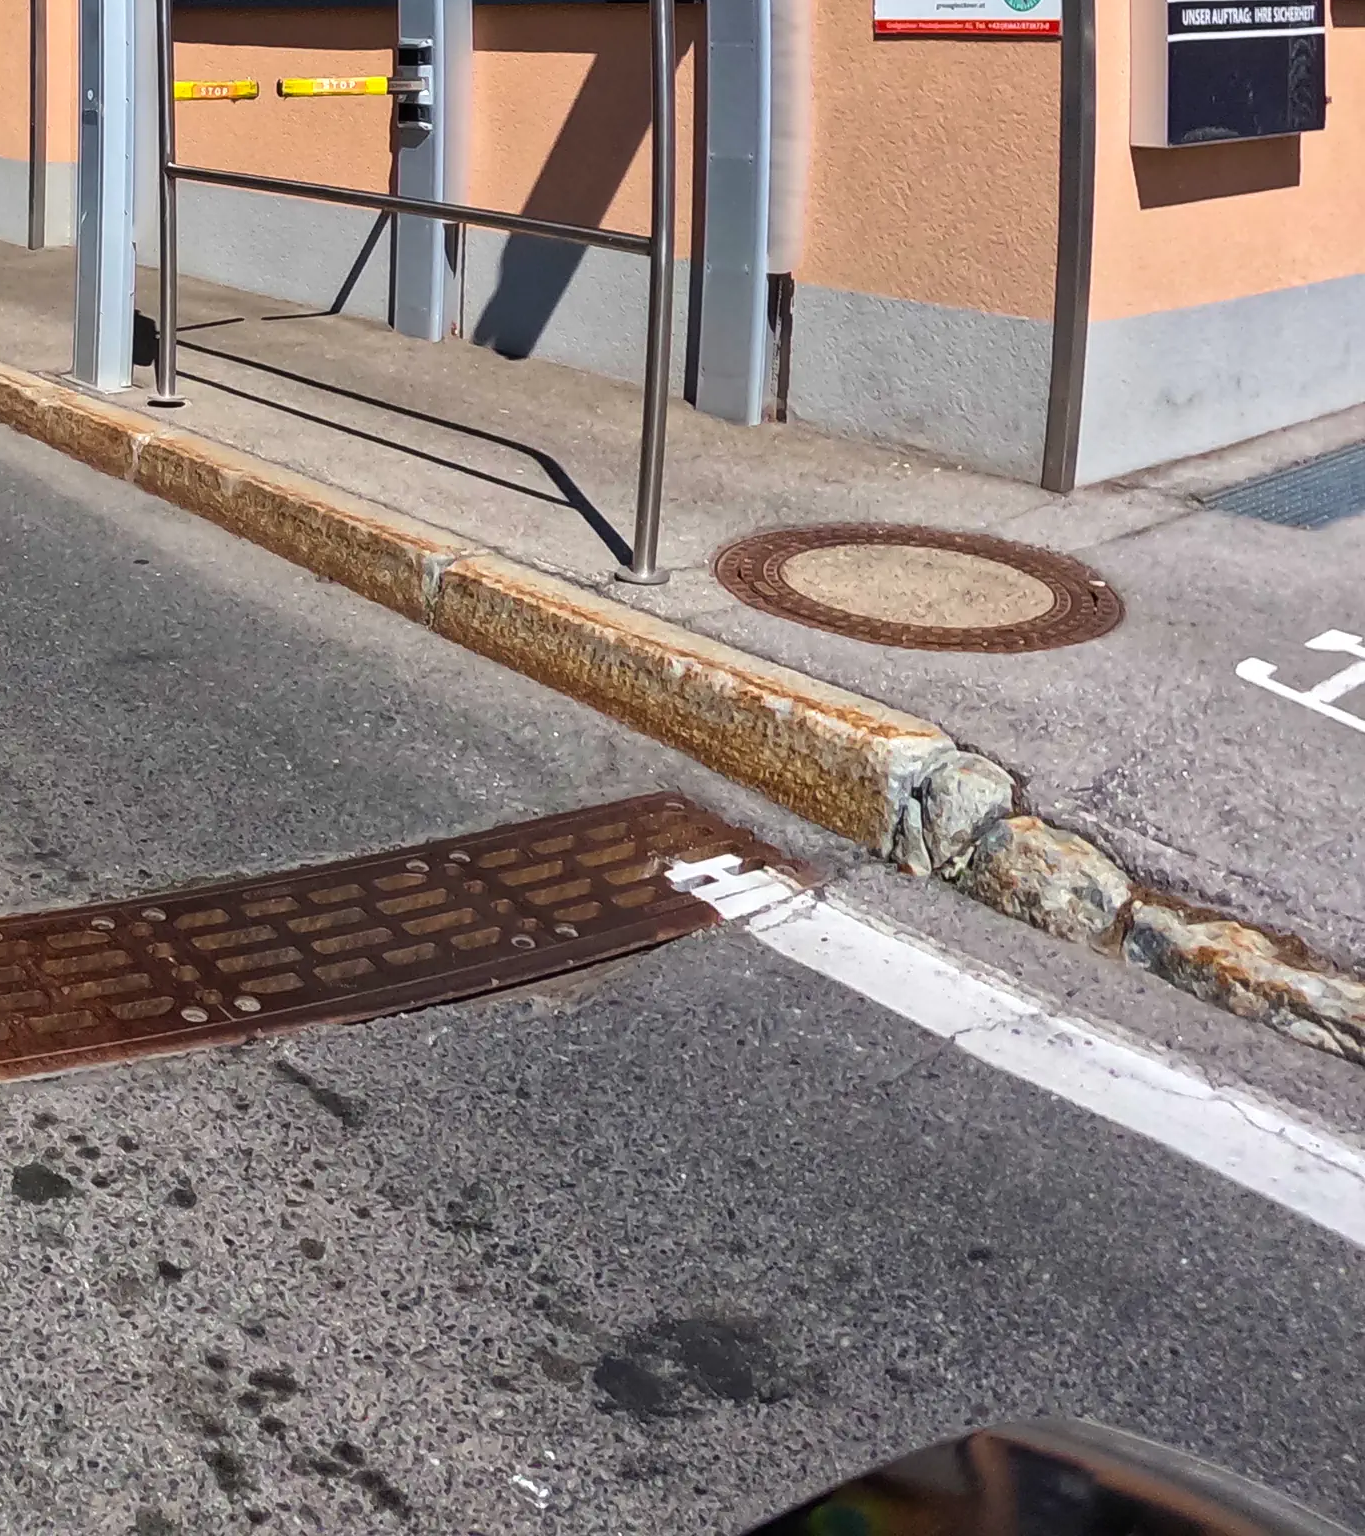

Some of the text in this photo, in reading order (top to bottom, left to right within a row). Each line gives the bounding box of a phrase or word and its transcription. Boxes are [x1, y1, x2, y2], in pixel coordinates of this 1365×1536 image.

[1182, 9, 1210, 25] UNSER
[1254, 7, 1272, 22] IHRE
[1273, 5, 1315, 22] SICHERHEIT
[322, 79, 356, 90] STOP
[200, 86, 228, 96] STOP
